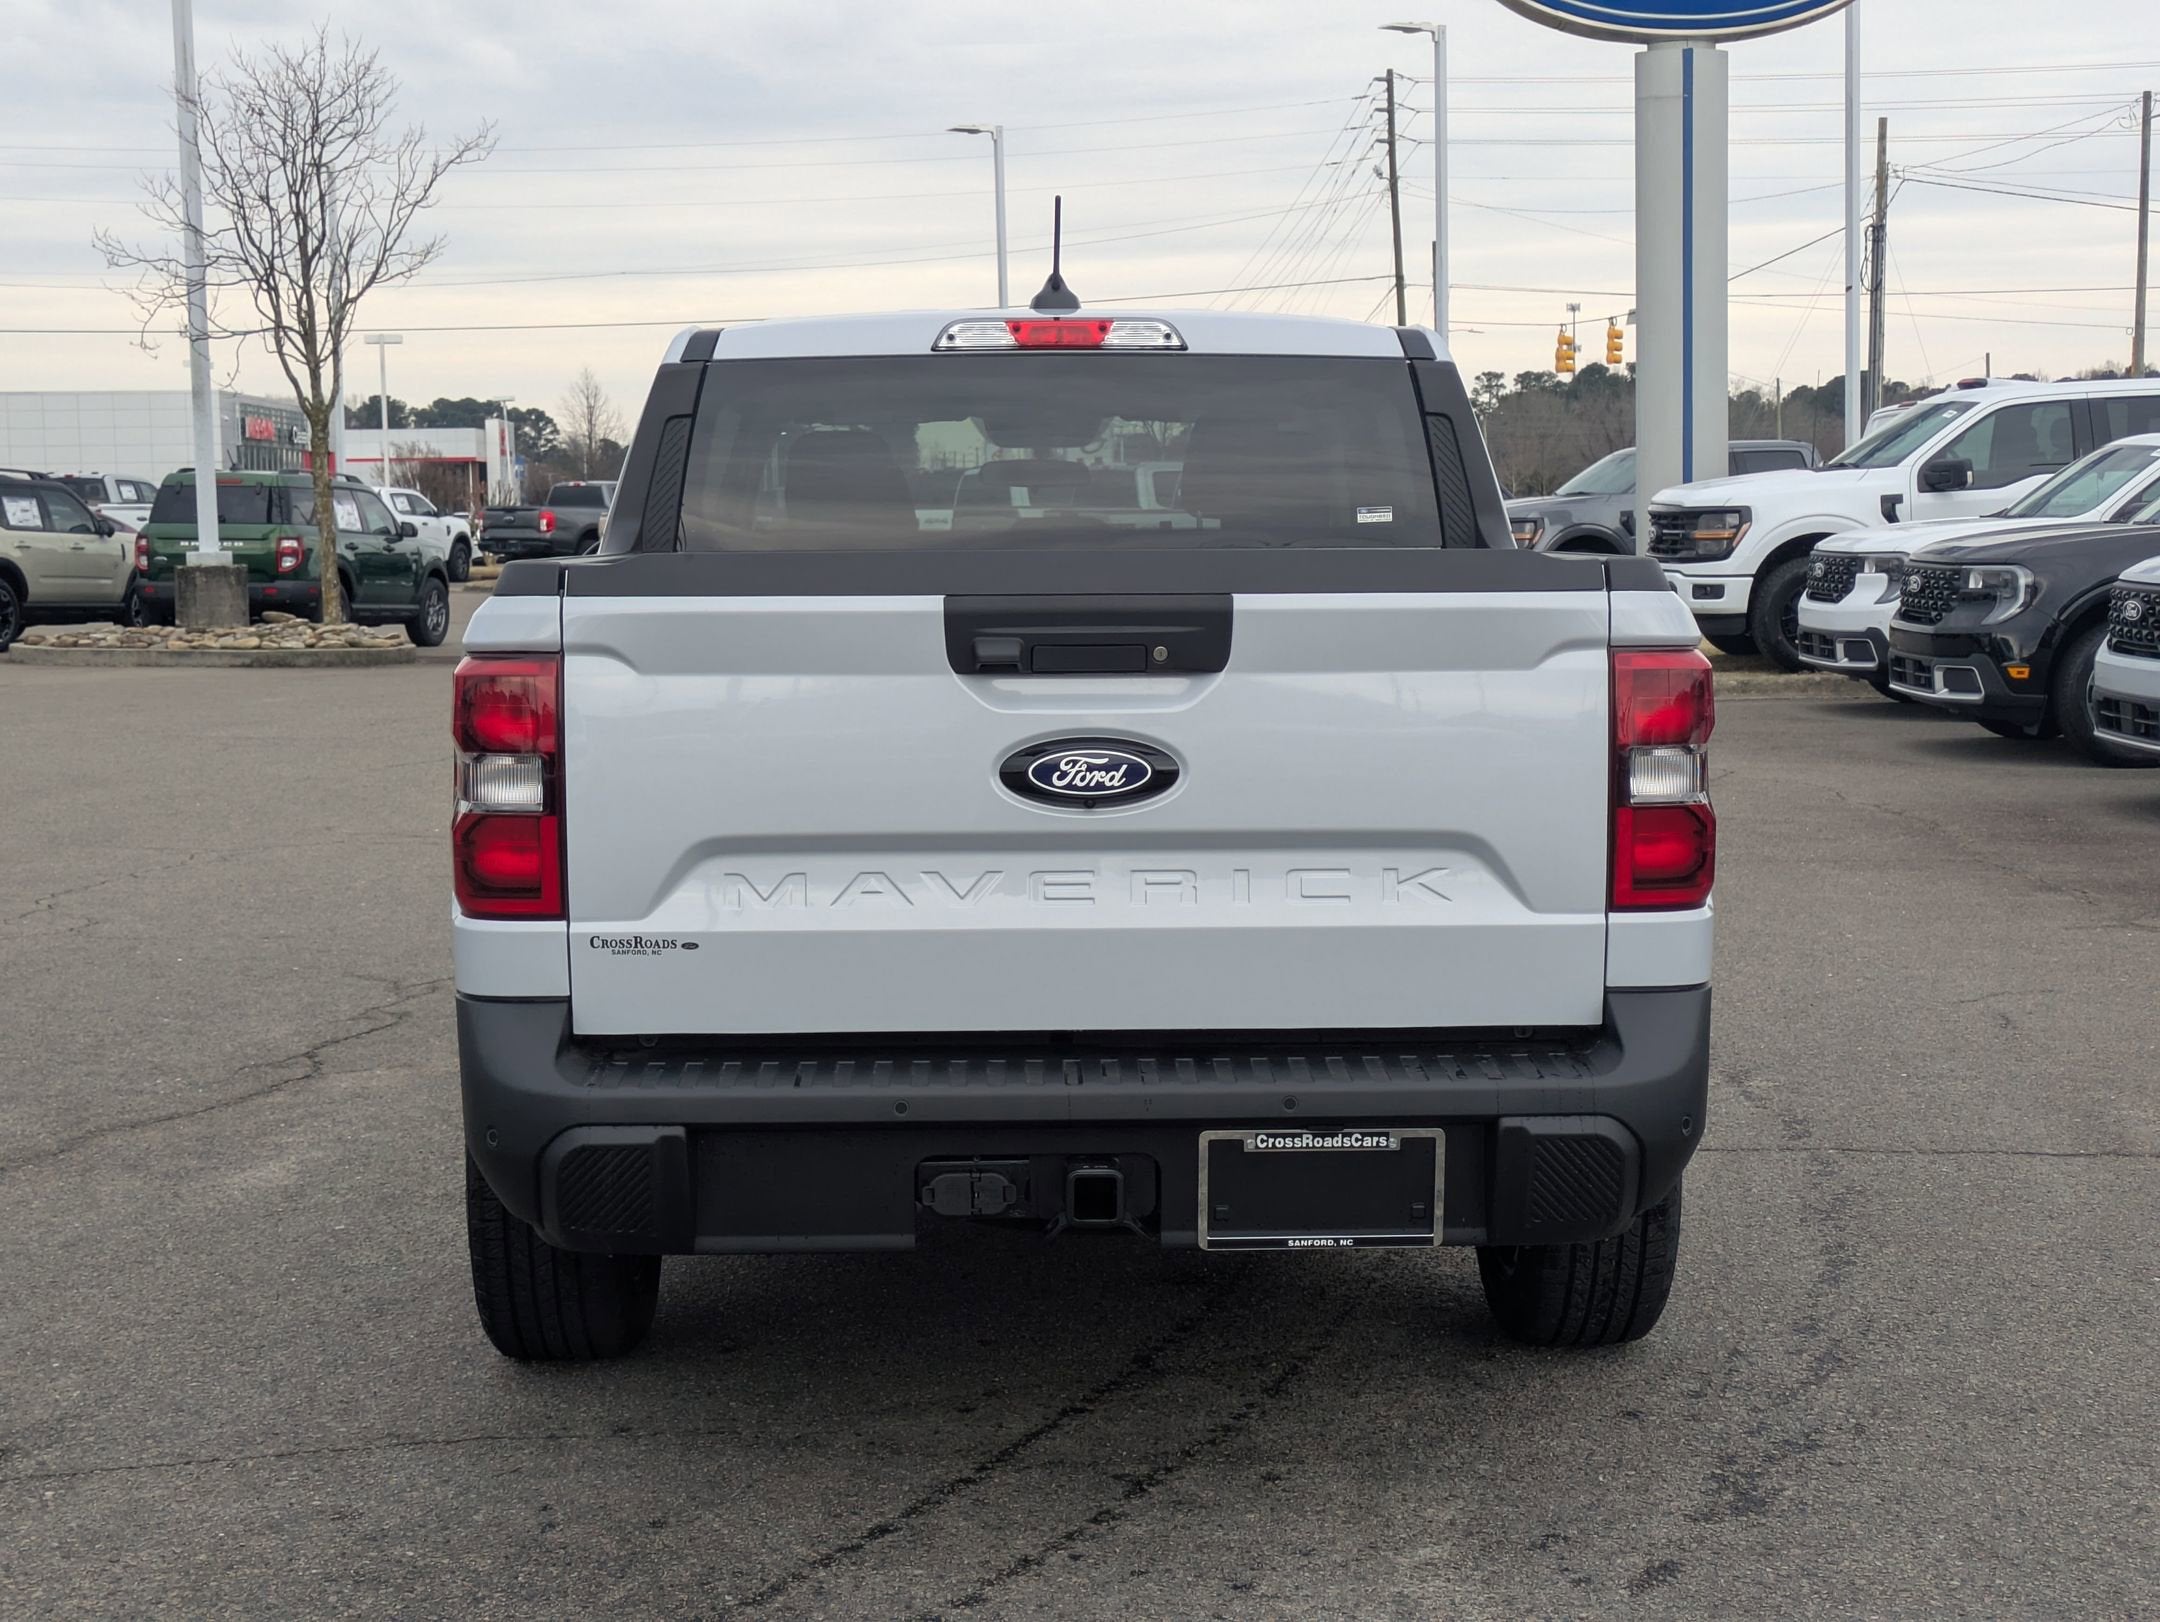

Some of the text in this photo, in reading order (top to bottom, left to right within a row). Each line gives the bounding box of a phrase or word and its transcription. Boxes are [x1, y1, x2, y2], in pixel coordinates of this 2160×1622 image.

[1052, 756, 1128, 787] Ford
[723, 868, 1453, 910] MAVERICK
[1256, 1133, 1388, 1149] CrossRoadsCars
[1288, 1239, 1354, 1248] SANFORD, NC
